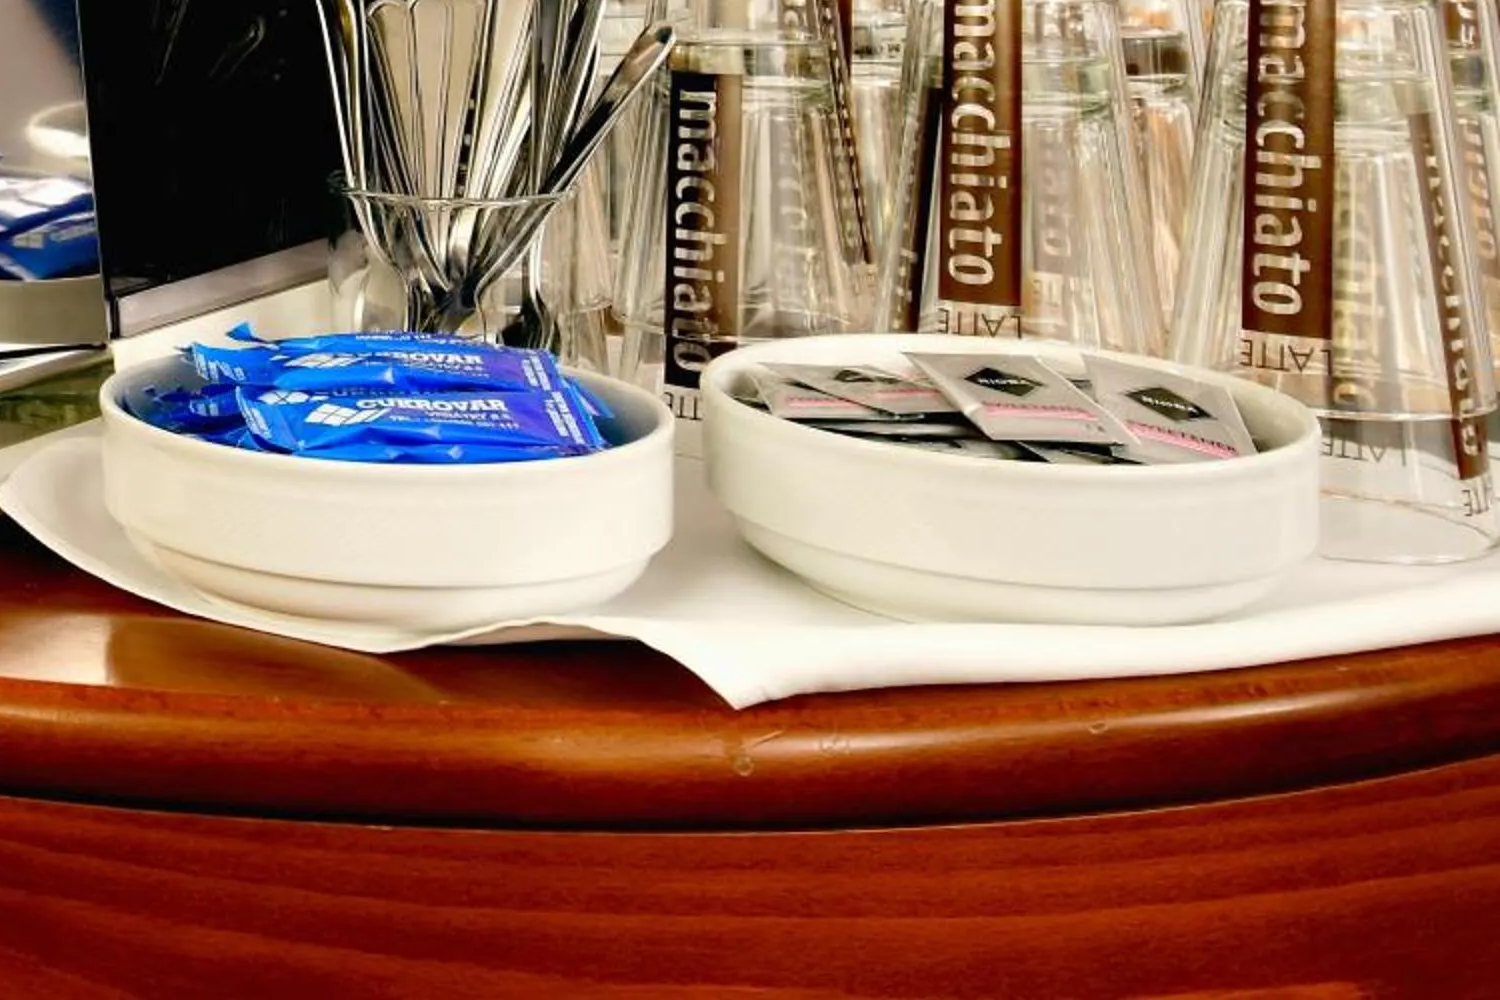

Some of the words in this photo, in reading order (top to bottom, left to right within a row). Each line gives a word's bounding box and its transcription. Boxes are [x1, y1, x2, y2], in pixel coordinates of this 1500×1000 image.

[673, 89, 727, 373] macchiato
[937, 307, 1022, 339] LATTE
[1240, 339, 1333, 375] LATTE
